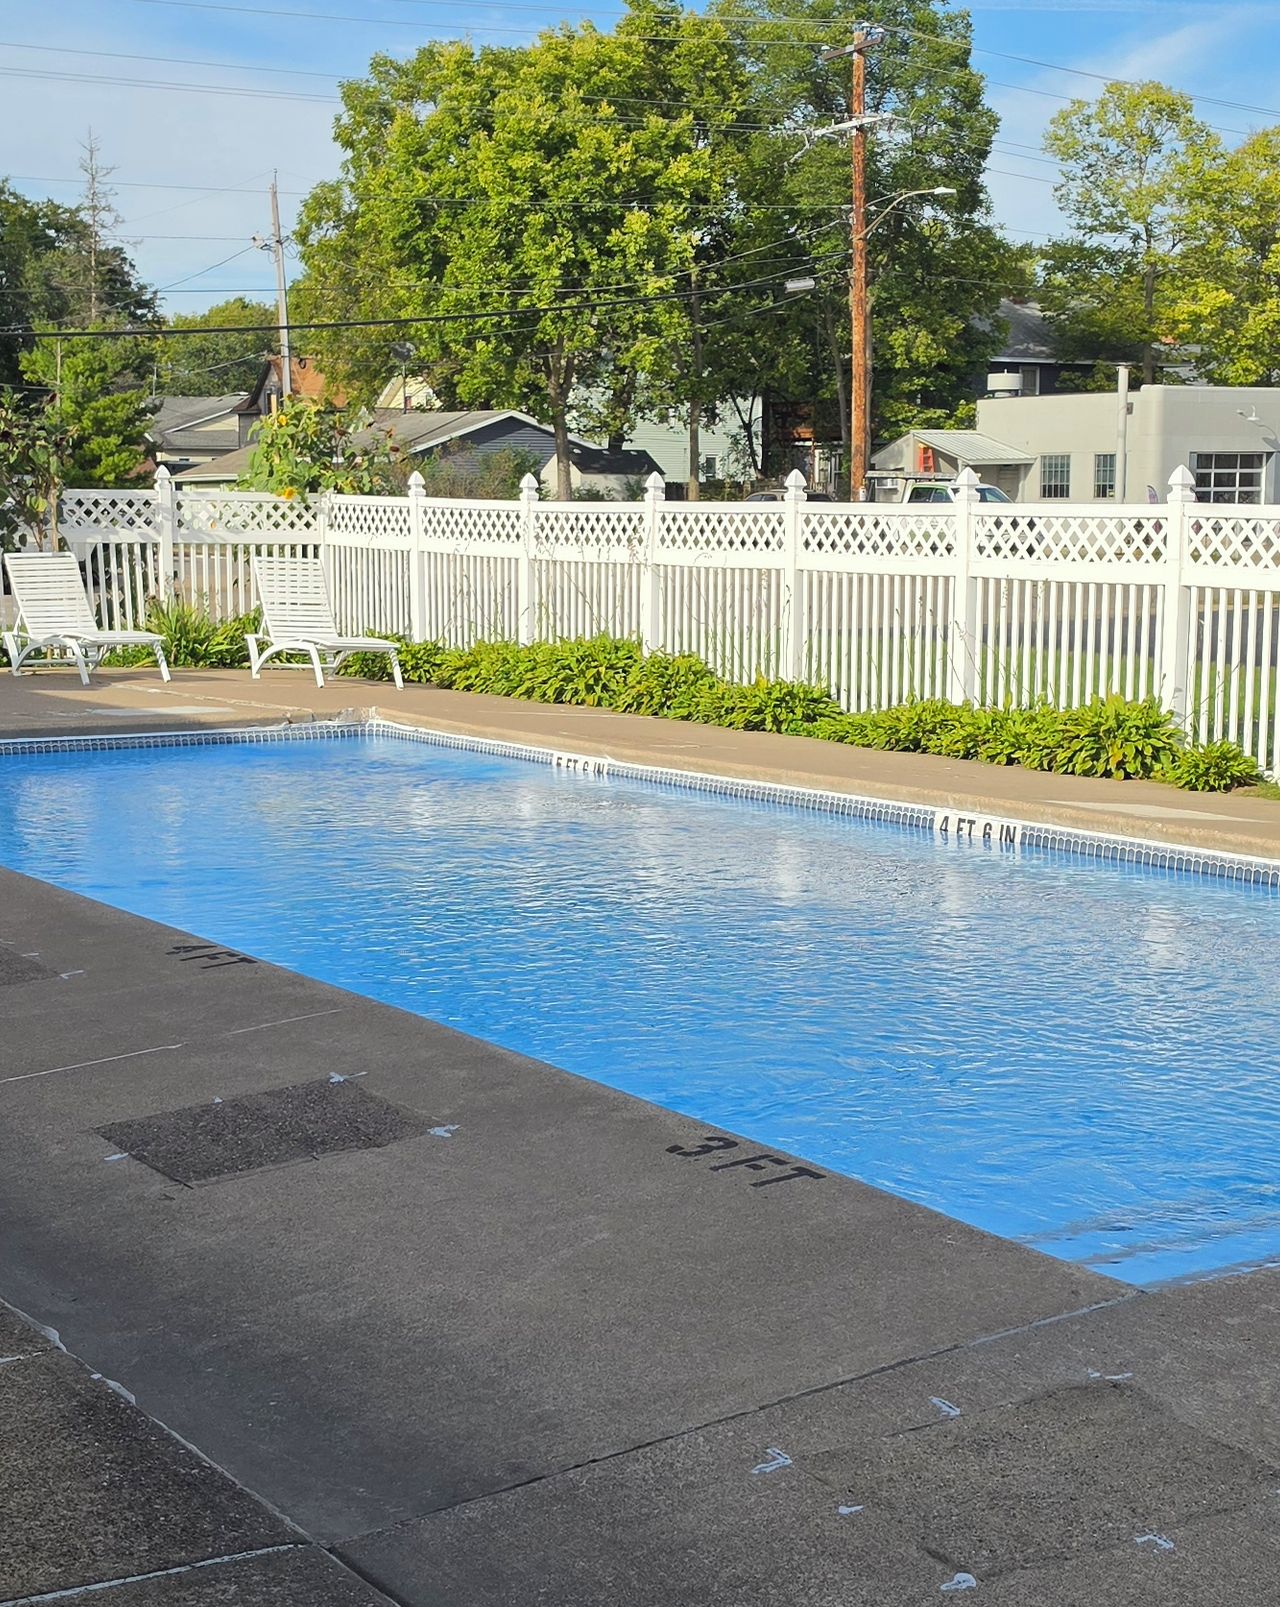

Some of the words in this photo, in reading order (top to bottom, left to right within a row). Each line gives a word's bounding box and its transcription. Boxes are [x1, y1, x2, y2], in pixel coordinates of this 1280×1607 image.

[939, 816, 949, 832] 4
[957, 818, 976, 836] FT
[983, 822, 992, 838] 6
[999, 824, 1016, 843] IN
[179, 951, 258, 969] FT
[666, 1136, 739, 1157] 3
[709, 1154, 827, 1187] FT
